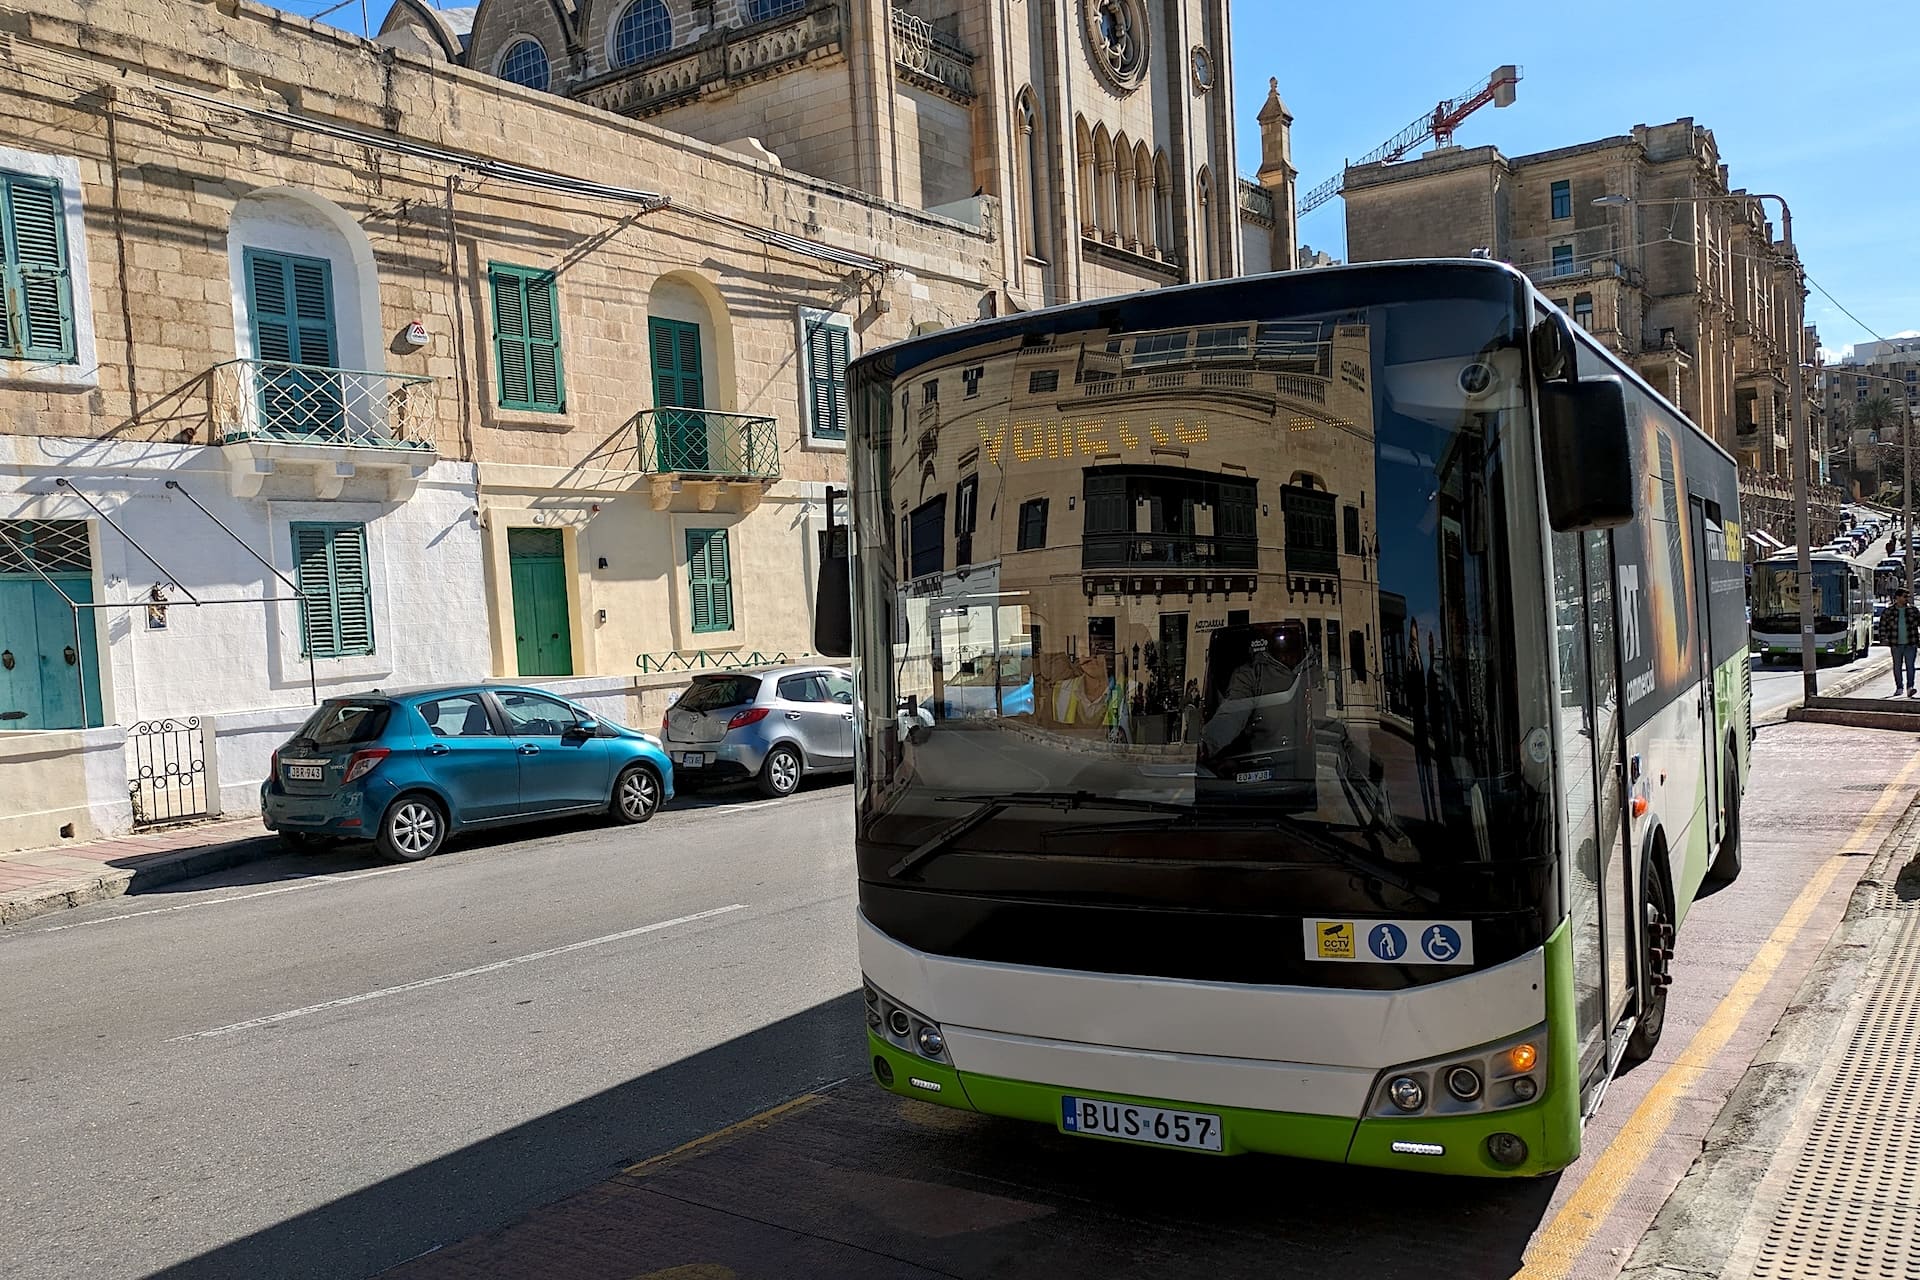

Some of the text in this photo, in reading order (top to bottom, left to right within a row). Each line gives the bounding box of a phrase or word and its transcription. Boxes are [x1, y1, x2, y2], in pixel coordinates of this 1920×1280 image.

[1323, 939, 1350, 949] CCTV
[1066, 1102, 1212, 1145] M BUS 657
